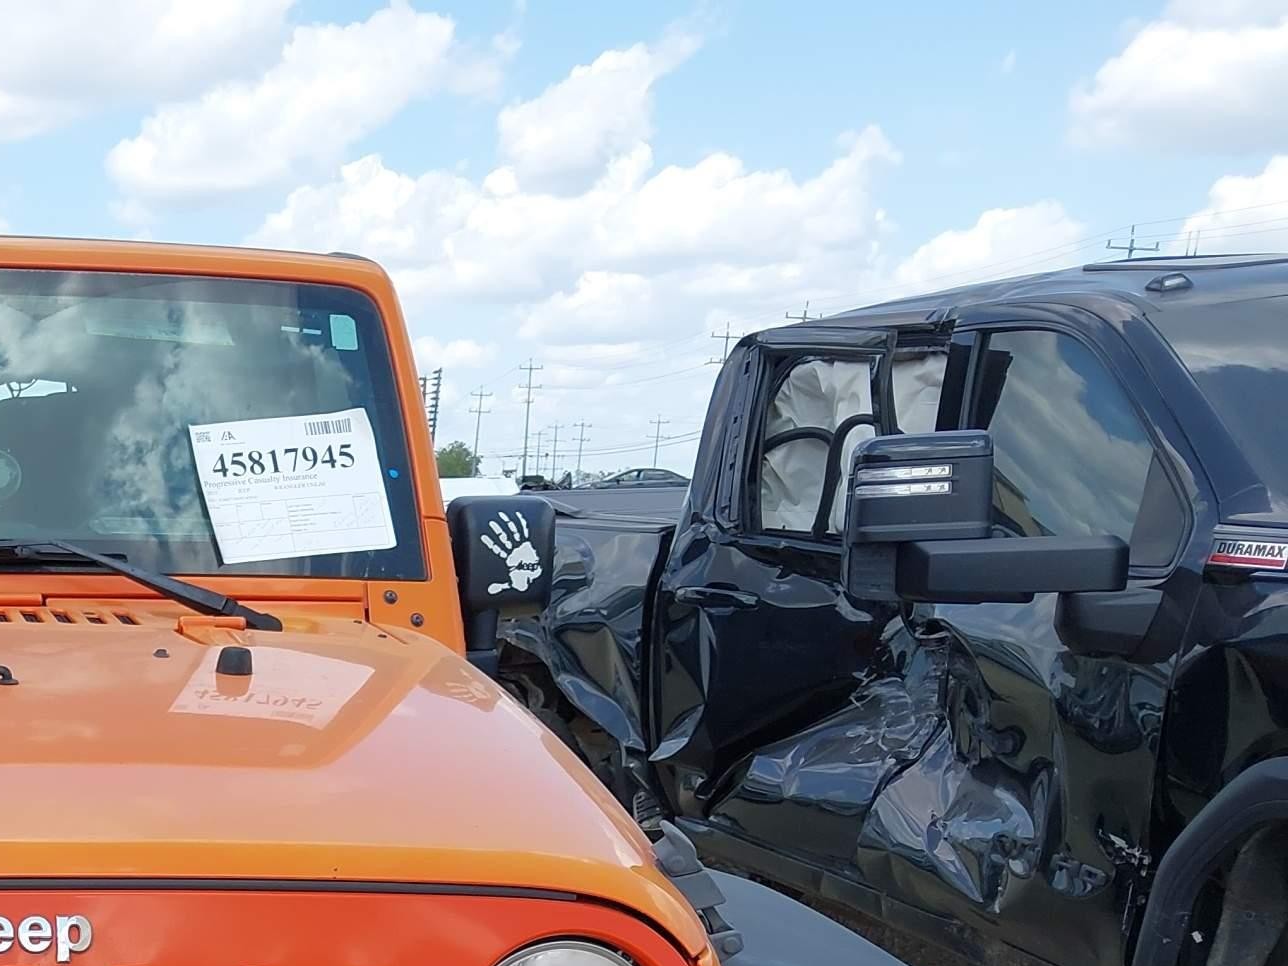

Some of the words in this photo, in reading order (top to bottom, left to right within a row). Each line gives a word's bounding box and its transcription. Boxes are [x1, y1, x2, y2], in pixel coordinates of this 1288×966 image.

[212, 443, 355, 478] 45817945
[203, 479, 245, 489] Progressive
[248, 476, 280, 485] Casualty
[283, 473, 318, 482] Insurance
[1217, 542, 1286, 558] DURAMAX
